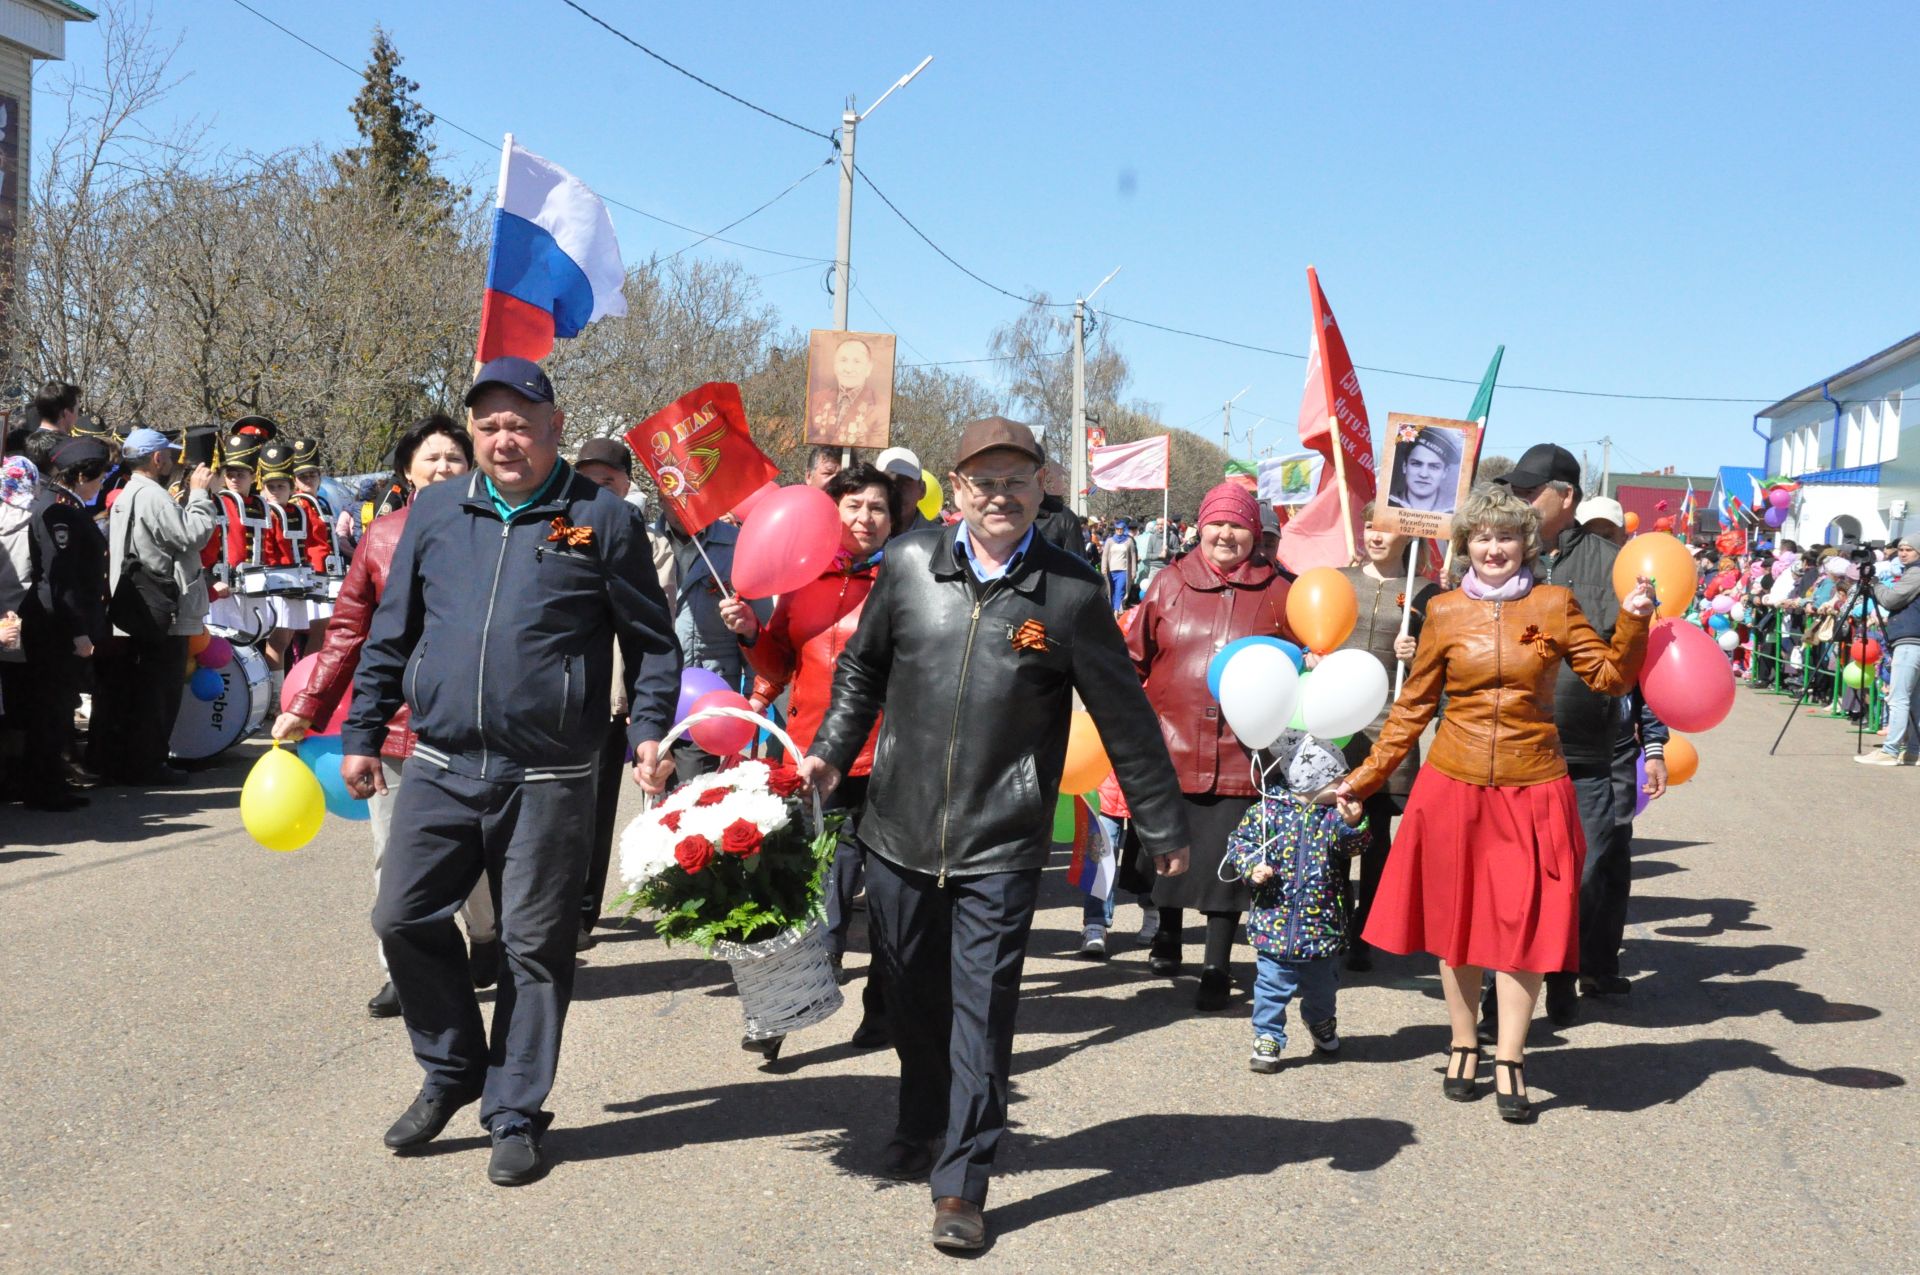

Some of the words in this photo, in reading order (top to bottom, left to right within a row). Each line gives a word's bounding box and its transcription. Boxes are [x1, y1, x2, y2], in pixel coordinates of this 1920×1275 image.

[651, 431, 671, 456] 9
[672, 400, 718, 443] МАЯ
[1400, 526, 1415, 534] 1927
